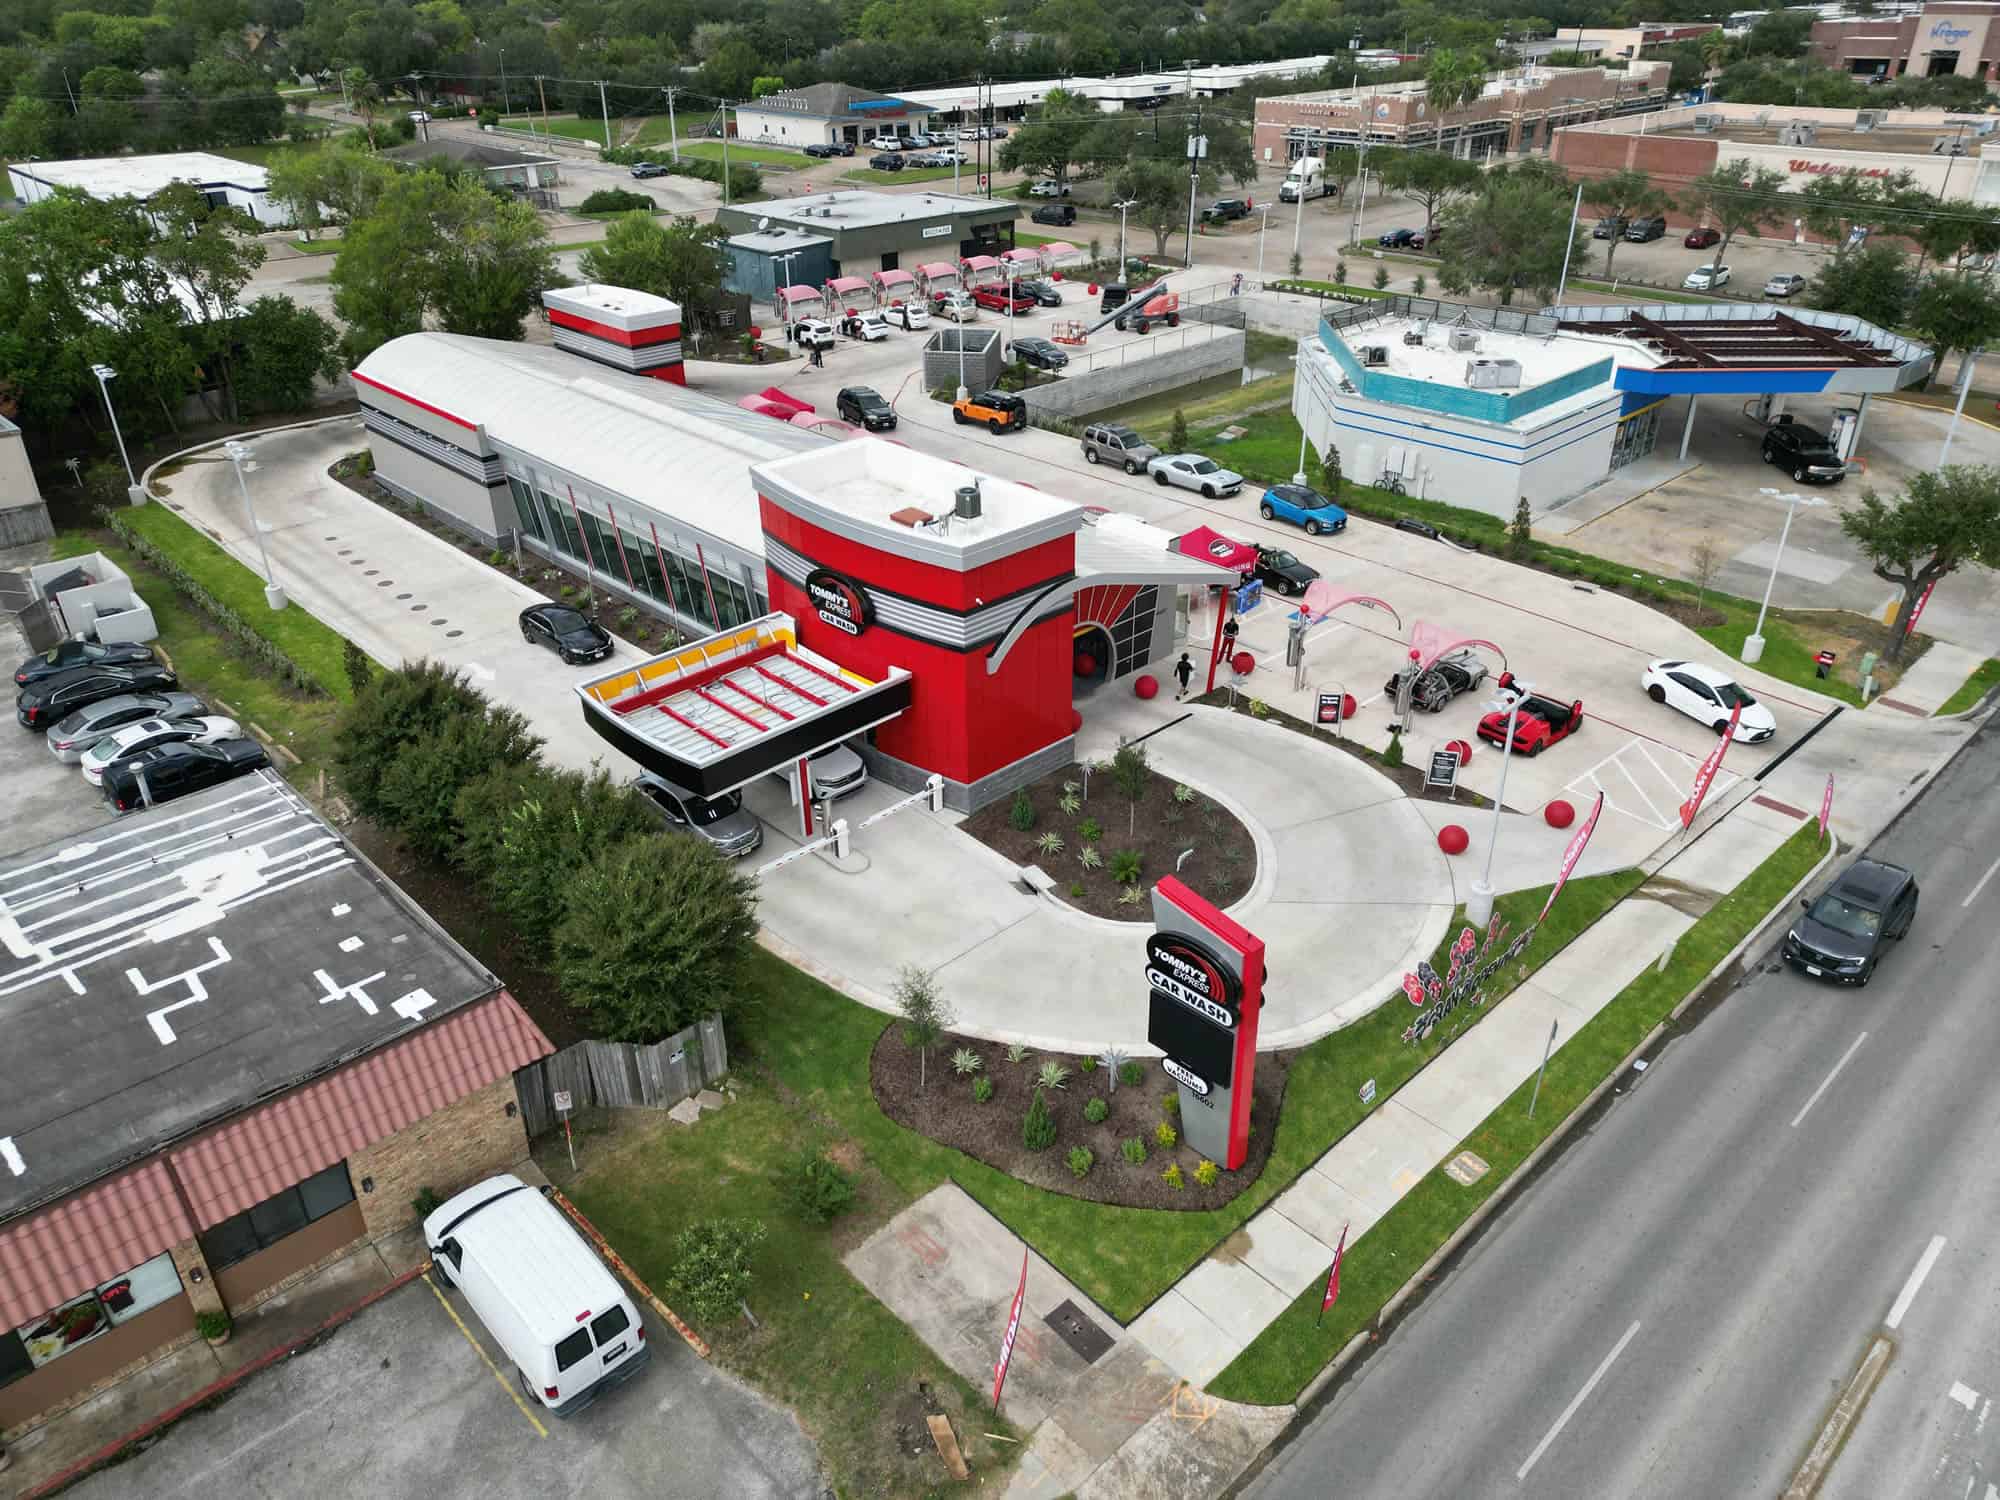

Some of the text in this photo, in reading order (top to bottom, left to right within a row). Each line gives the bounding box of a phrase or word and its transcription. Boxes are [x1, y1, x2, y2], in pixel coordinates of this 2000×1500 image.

[836, 618, 855, 632] WASH
[1153, 946, 1208, 982] TOMMY'S
[1173, 968, 1210, 993] EXPRESS
[1152, 974, 1227, 1022] CAR WASH
[1166, 1065, 1203, 1092] VACUUMS
